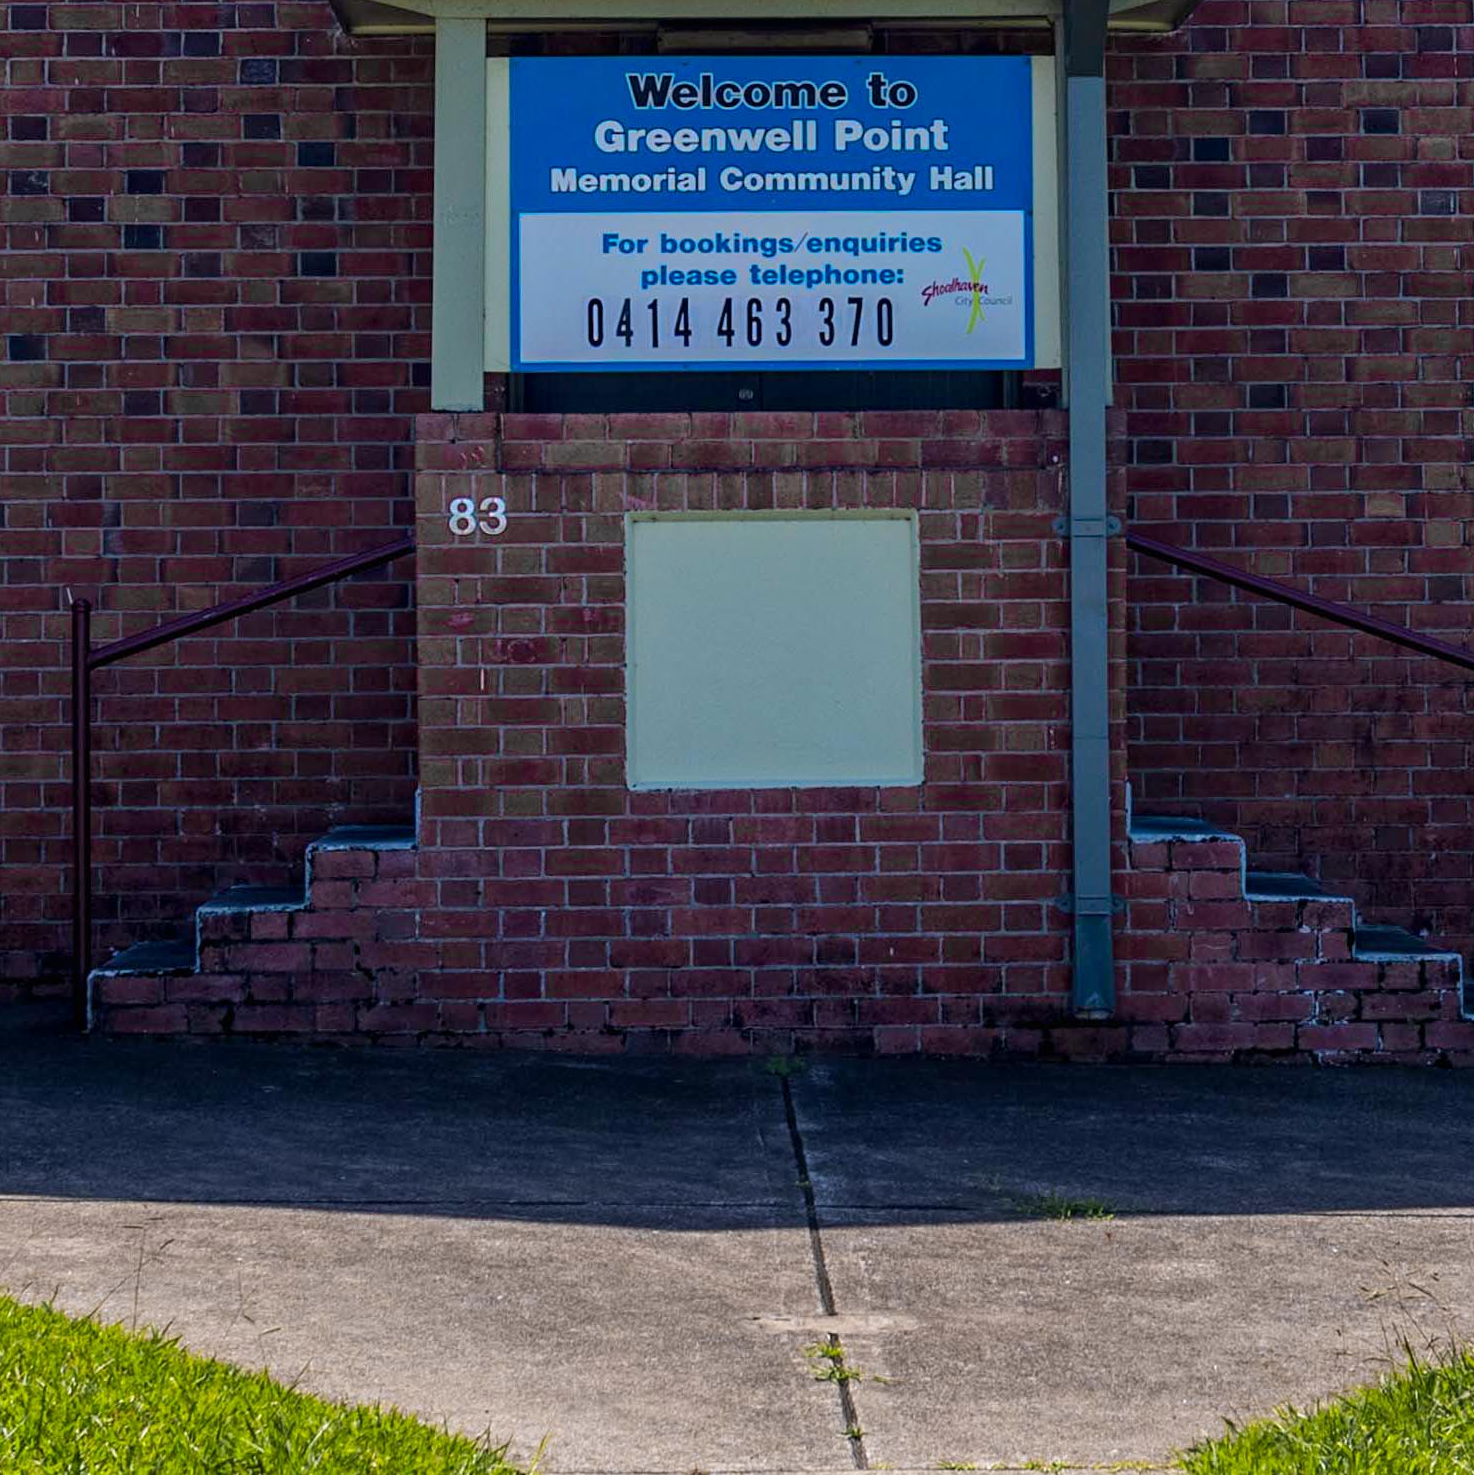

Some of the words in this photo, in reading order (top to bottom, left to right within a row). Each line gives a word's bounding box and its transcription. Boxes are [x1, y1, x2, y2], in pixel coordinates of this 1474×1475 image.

[626, 72, 847, 110] Welcome
[867, 71, 917, 110] to
[593, 119, 816, 153] Greenwell
[834, 119, 949, 153] Point
[549, 165, 705, 193] Memorial
[719, 165, 914, 196] Community
[929, 165, 993, 191] Hall
[601, 233, 649, 255] For
[660, 231, 942, 257] bookings/enquiries
[641, 265, 737, 288] please
[749, 263, 905, 288] telephone:
[979, 295, 1013, 306] Council
[586, 298, 693, 347] 0414
[717, 298, 792, 347] 463
[819, 298, 894, 347] 370
[449, 497, 507, 535] 83
